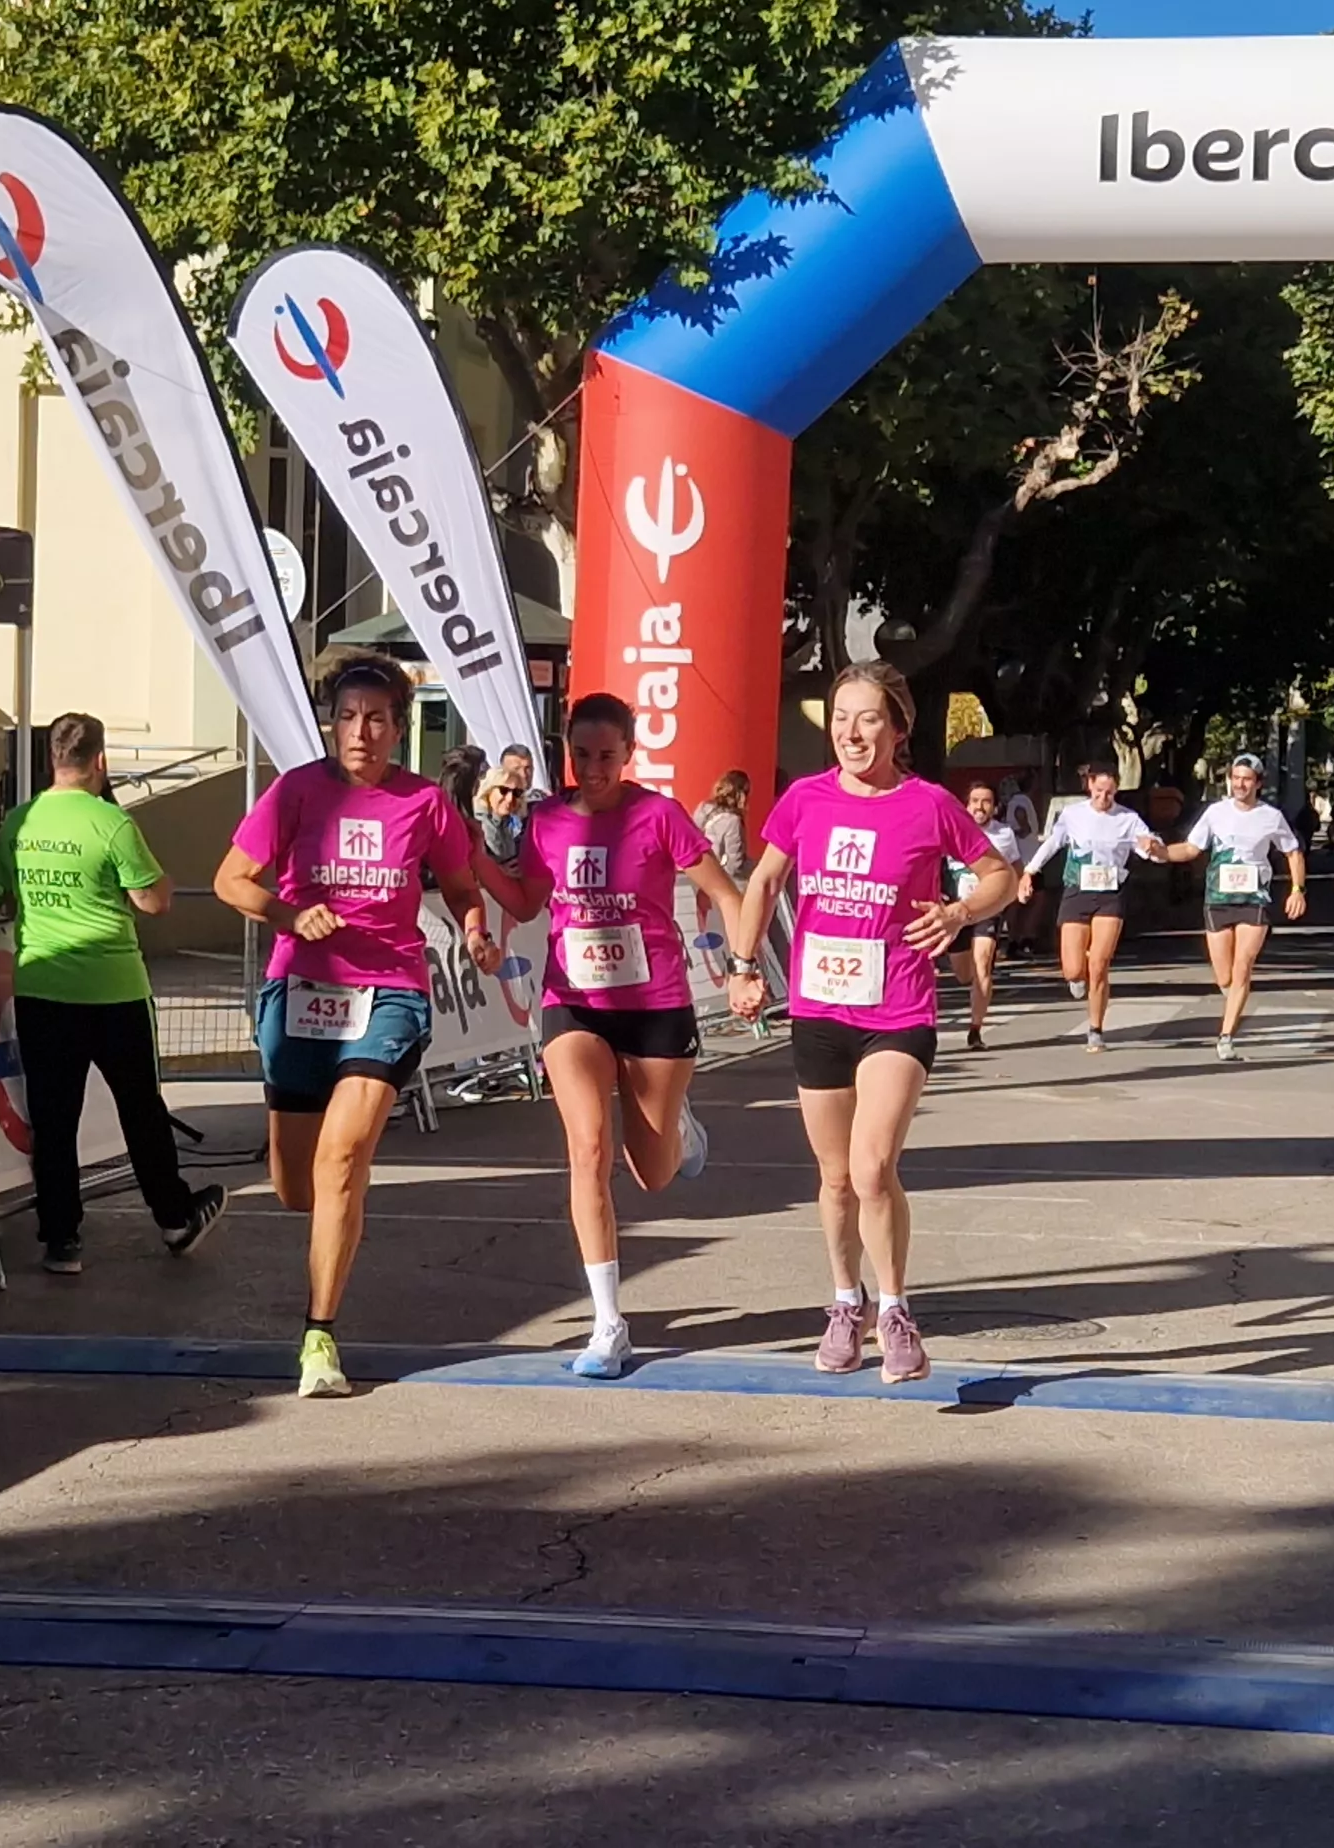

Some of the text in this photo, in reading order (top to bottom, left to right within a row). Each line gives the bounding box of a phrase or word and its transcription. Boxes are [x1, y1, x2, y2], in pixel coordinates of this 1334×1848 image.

[799, 868, 899, 907] salesianos
[816, 897, 874, 920] HUESCA
[582, 943, 626, 962] 430
[816, 955, 864, 977] 432
[306, 996, 351, 1018] 431
